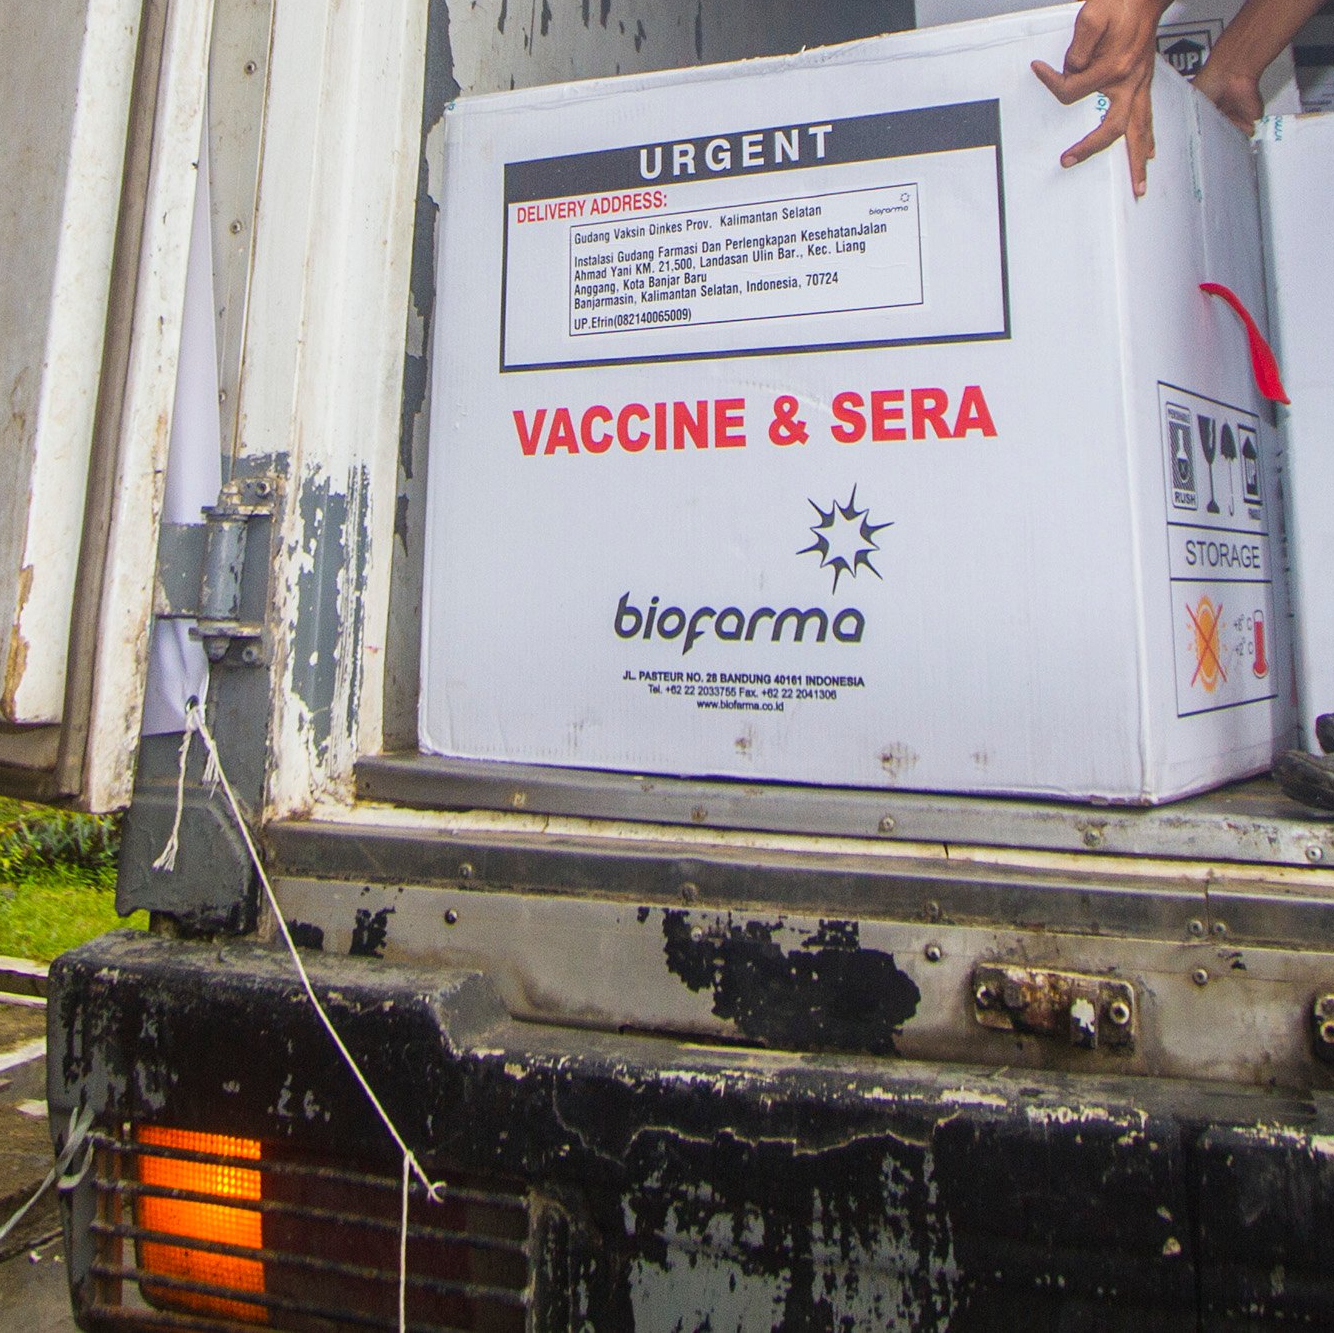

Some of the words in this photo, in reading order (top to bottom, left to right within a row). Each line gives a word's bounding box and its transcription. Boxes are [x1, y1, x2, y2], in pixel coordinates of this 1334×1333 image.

[639, 124, 833, 180] URGENT
[516, 199, 587, 224] DELIVERY
[589, 190, 668, 216] ADDRESS:
[574, 232, 610, 245] Gudang
[614, 225, 645, 240] Vaksin
[649, 221, 682, 236] Dinkes
[686, 219, 712, 231] Prov.
[720, 211, 778, 227] Kalimantan
[782, 205, 822, 221] Selatan
[574, 253, 614, 267] Instalasi
[618, 249, 654, 263] Gudang
[658, 243, 698, 258] Farmasi
[701, 240, 722, 253] Dan
[725, 233, 797, 249] Perlengkapan
[801, 222, 887, 242] KesehatanJalan
[574, 268, 607, 282] Ahmad
[610, 264, 632, 278] Yani
[635, 262, 655, 276] KM.
[700, 253, 749, 268] Landasan
[752, 249, 774, 262] Ulin
[778, 246, 804, 260] Bar.,
[807, 244, 832, 256] Kec.
[836, 240, 866, 254] Liang
[574, 283, 619, 297] Anggang,
[623, 277, 645, 291] Kota
[648, 275, 680, 290] Banjar
[684, 271, 707, 284] Baru
[574, 294, 637, 310] Banjarmasin,
[641, 285, 697, 303] Kalimantan
[700, 282, 743, 298] Selatan,
[746, 276, 802, 293] Indonesia,
[806, 271, 839, 287] 70724
[512, 397, 747, 456] VACCINE
[768, 395, 809, 446] &
[831, 385, 999, 444] SERA
[1175, 491, 1195, 506] RUSH
[1186, 539, 1261, 569] STORAGE
[614, 591, 866, 656] biofarma
[639, 671, 684, 683] PASTEUR
[687, 672, 704, 683] NO.
[706, 673, 718, 683] 28
[720, 673, 771, 685] BANDUNG
[774, 675, 803, 686] 40161
[805, 675, 865, 687] INDONESIA
[647, 684, 661, 694] Tel.
[684, 685, 695, 695] 22
[739, 687, 759, 697] Fax.
[781, 688, 793, 699] 22
[696, 699, 784, 711] www.biofarma.co.id
